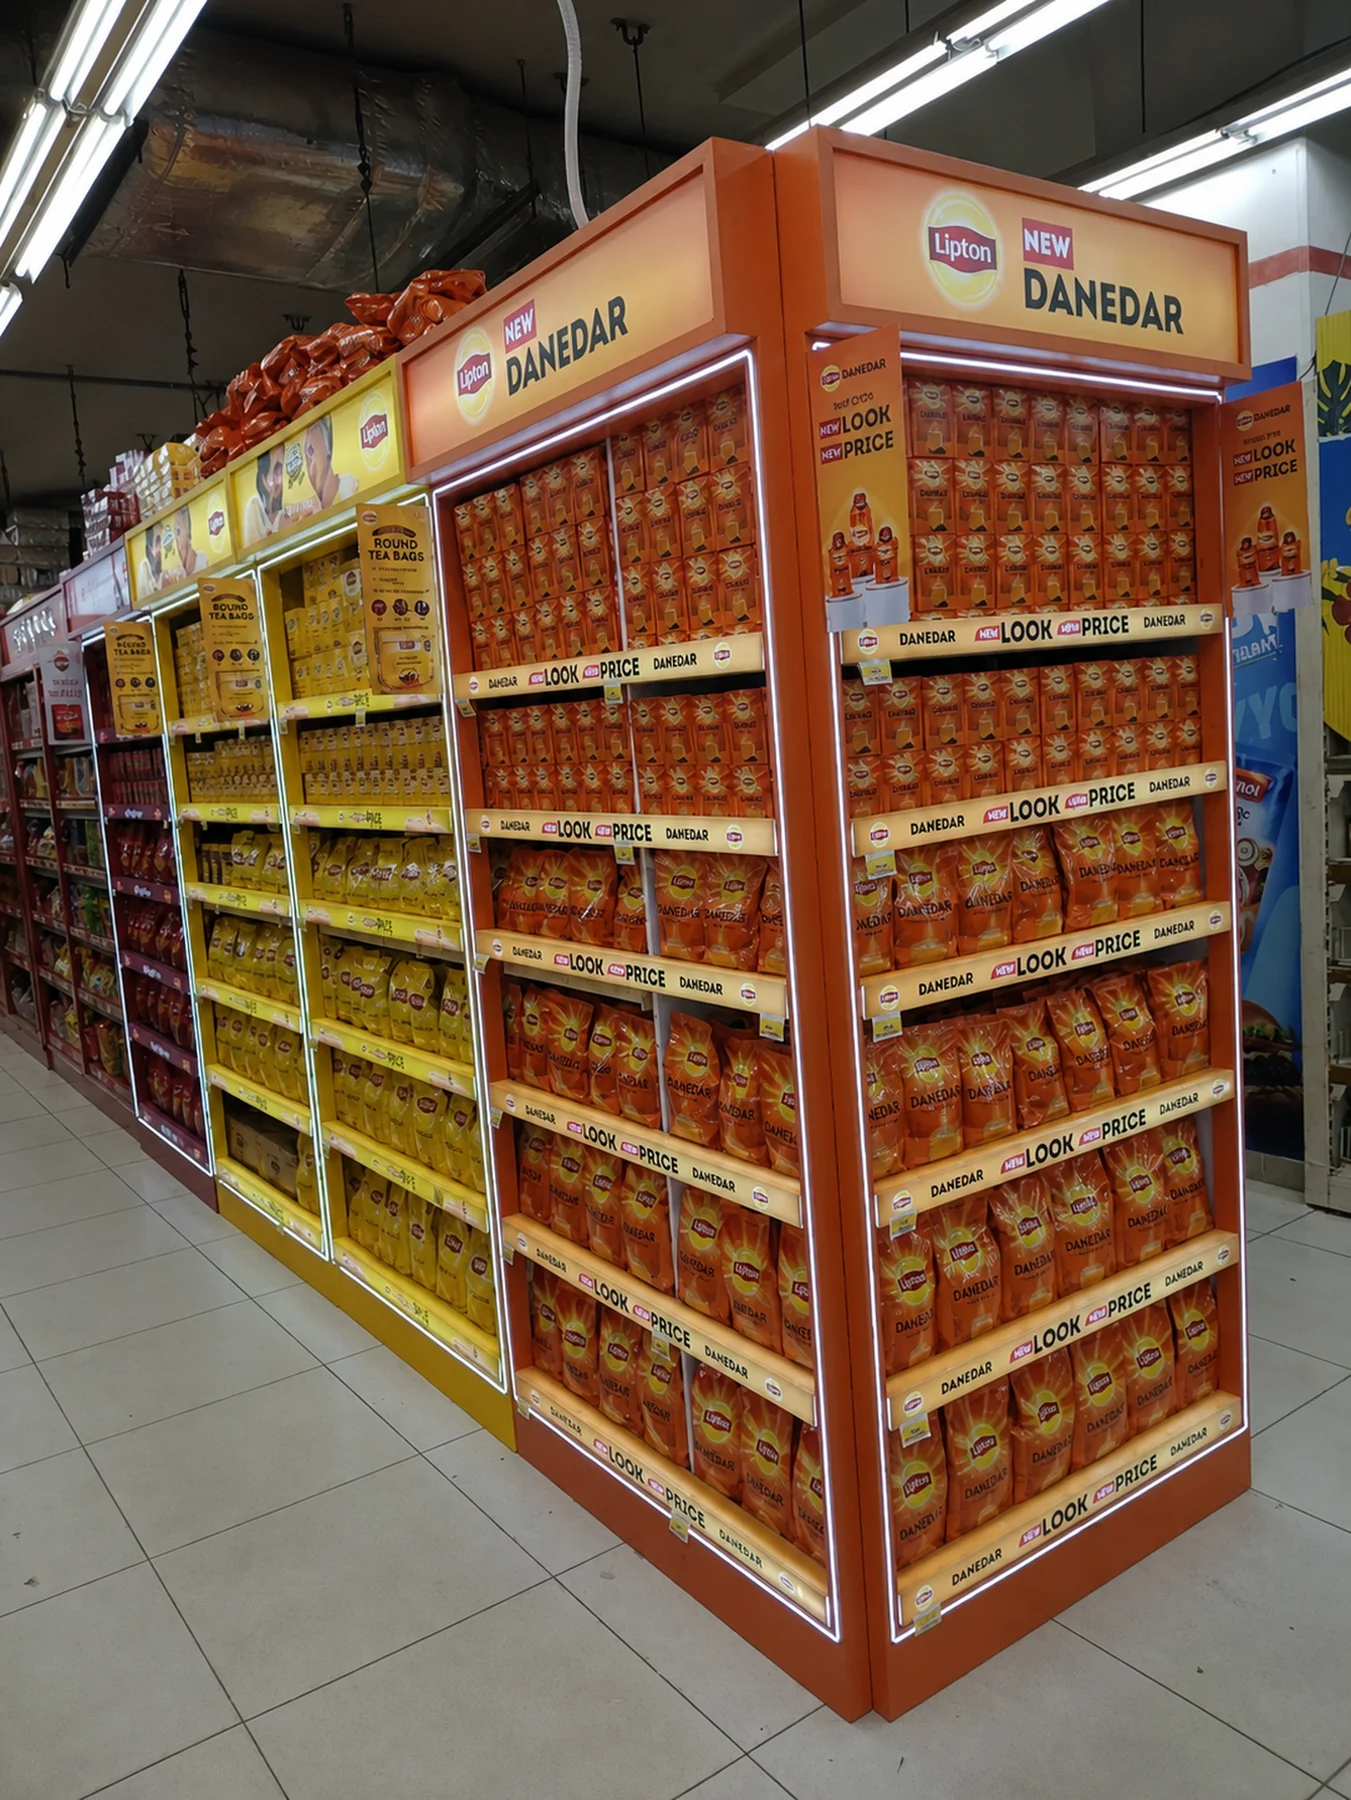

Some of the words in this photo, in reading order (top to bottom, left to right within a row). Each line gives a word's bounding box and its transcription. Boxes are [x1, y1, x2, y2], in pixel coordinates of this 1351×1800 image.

[934, 233, 992, 263] Lipton
[1024, 228, 1070, 258] NEW
[1024, 268, 1184, 334] DANEDAR
[504, 308, 534, 345] NEW
[506, 296, 628, 396] DANEDAR
[459, 360, 489, 391] Lipton
[842, 358, 886, 379] DANEDAR
[842, 404, 891, 434] LOOK
[822, 447, 841, 462] NEW
[844, 430, 894, 459] PRICE
[1254, 439, 1295, 462] LOOK
[1255, 459, 1297, 481] PRICE
[368, 550, 390, 561] TEA
[393, 550, 424, 561] BAGS
[374, 538, 418, 550] ROUND
[208, 612, 227, 620] TEA
[900, 630, 956, 646] DANEDAR
[1001, 620, 1053, 644] LOOK
[1081, 615, 1129, 636] PRICE
[1144, 614, 1186, 628] DANEDAR
[544, 665, 579, 686] LOOK
[600, 658, 640, 679] PRICE
[654, 653, 697, 670] DANEDAR
[911, 815, 965, 835] DANEDAR
[1009, 795, 1060, 822] LOOK
[1089, 782, 1135, 807] PRICE
[558, 820, 592, 839] LOOK
[613, 823, 652, 841] PRICE
[570, 953, 604, 975] LOOK
[626, 964, 666, 987] PRICE
[919, 972, 973, 996] DANEDAR
[1017, 947, 1066, 976] LOOK
[1095, 930, 1140, 957] PRICE
[1154, 920, 1194, 939] DANEDAR
[582, 1123, 617, 1151] LOOK
[639, 1145, 678, 1174] PRICE
[931, 1169, 984, 1198] DANEDAR
[1026, 1134, 1074, 1168] LOOK
[1102, 1109, 1146, 1139] PRICE
[594, 1279, 629, 1313] LOOK
[651, 1312, 690, 1348] PRICE
[941, 1361, 992, 1395] DANEDAR
[1034, 1315, 1081, 1354] LOOK
[1108, 1283, 1151, 1318] PRICE
[609, 1446, 644, 1484] LOOK
[666, 1488, 705, 1529] PRICE
[952, 1548, 1002, 1586] DANEDAR
[1042, 1494, 1087, 1536] LOOK
[1114, 1454, 1158, 1491] PRICE
